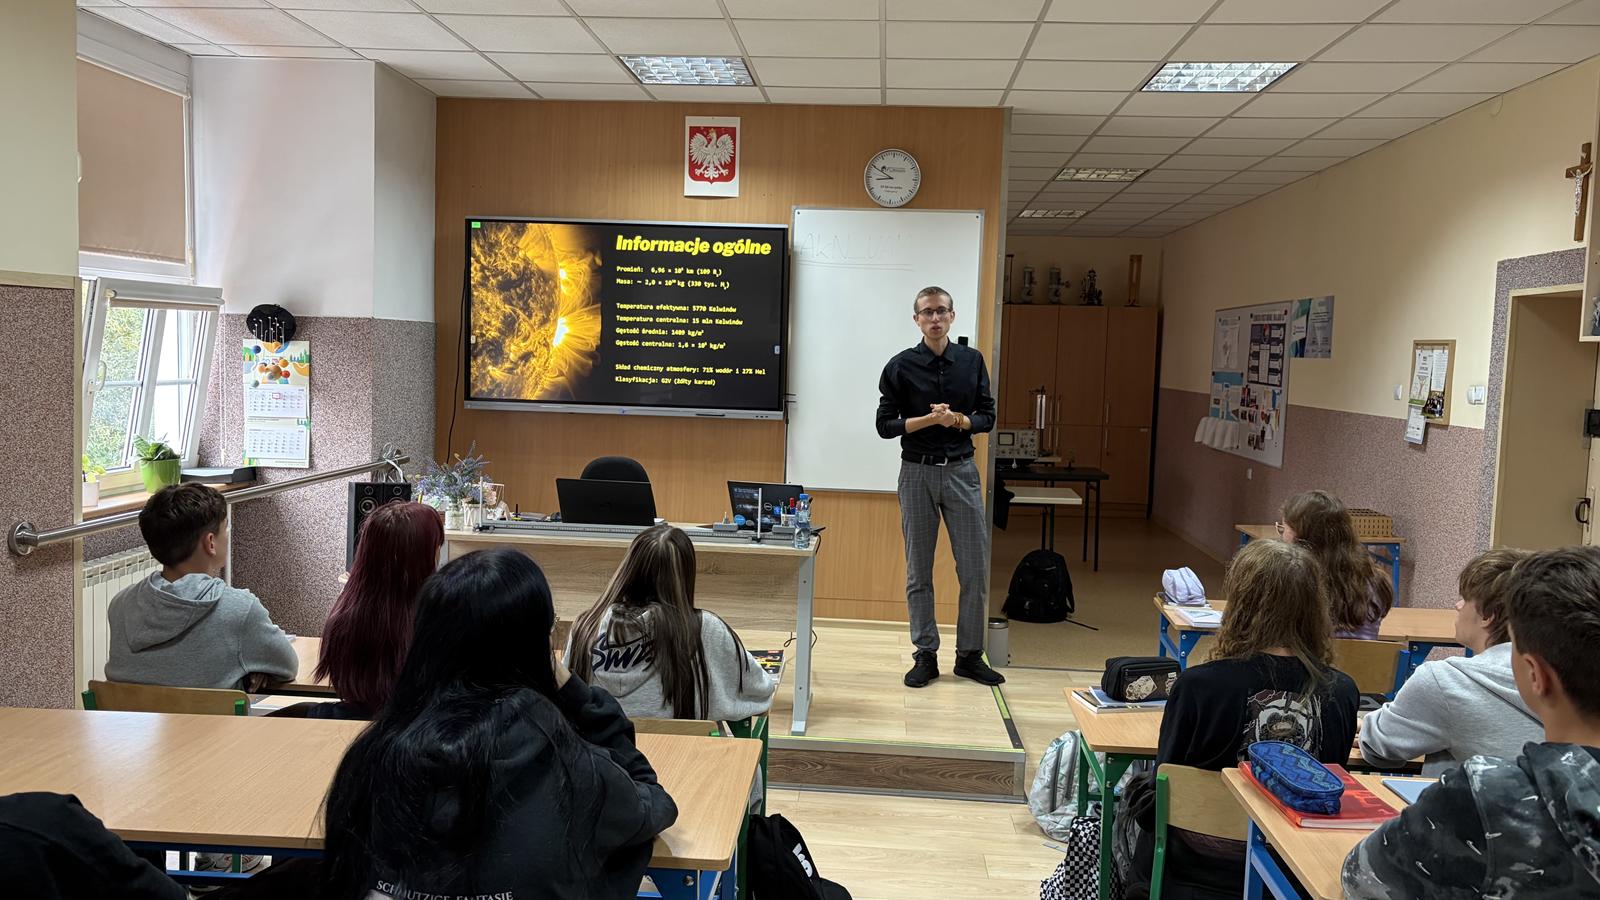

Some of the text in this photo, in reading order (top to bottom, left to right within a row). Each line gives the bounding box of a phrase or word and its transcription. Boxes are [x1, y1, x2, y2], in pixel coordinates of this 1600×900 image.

[615, 234, 712, 256] Informacje
[712, 238, 772, 258] ogólne
[615, 278, 634, 286] Masa:
[677, 280, 686, 288] kg
[703, 281, 718, 289] tys.
[615, 302, 654, 312] Temperatura
[655, 303, 690, 313] efektywna:
[708, 305, 737, 314] Kelwinów
[615, 314, 654, 324] Temperatura
[655, 316, 690, 325] centralna:
[714, 317, 744, 327] Kelwinów
[615, 327, 640, 337] Gęstość
[641, 327, 669, 337] średnia:
[615, 339, 640, 349] Gęstość
[641, 340, 675, 349] centralna:
[615, 363, 632, 372] Skład
[632, 364, 665, 374] chemiczny
[665, 365, 700, 374] atmosfery:
[614, 375, 659, 385] Klasyfikacja:
